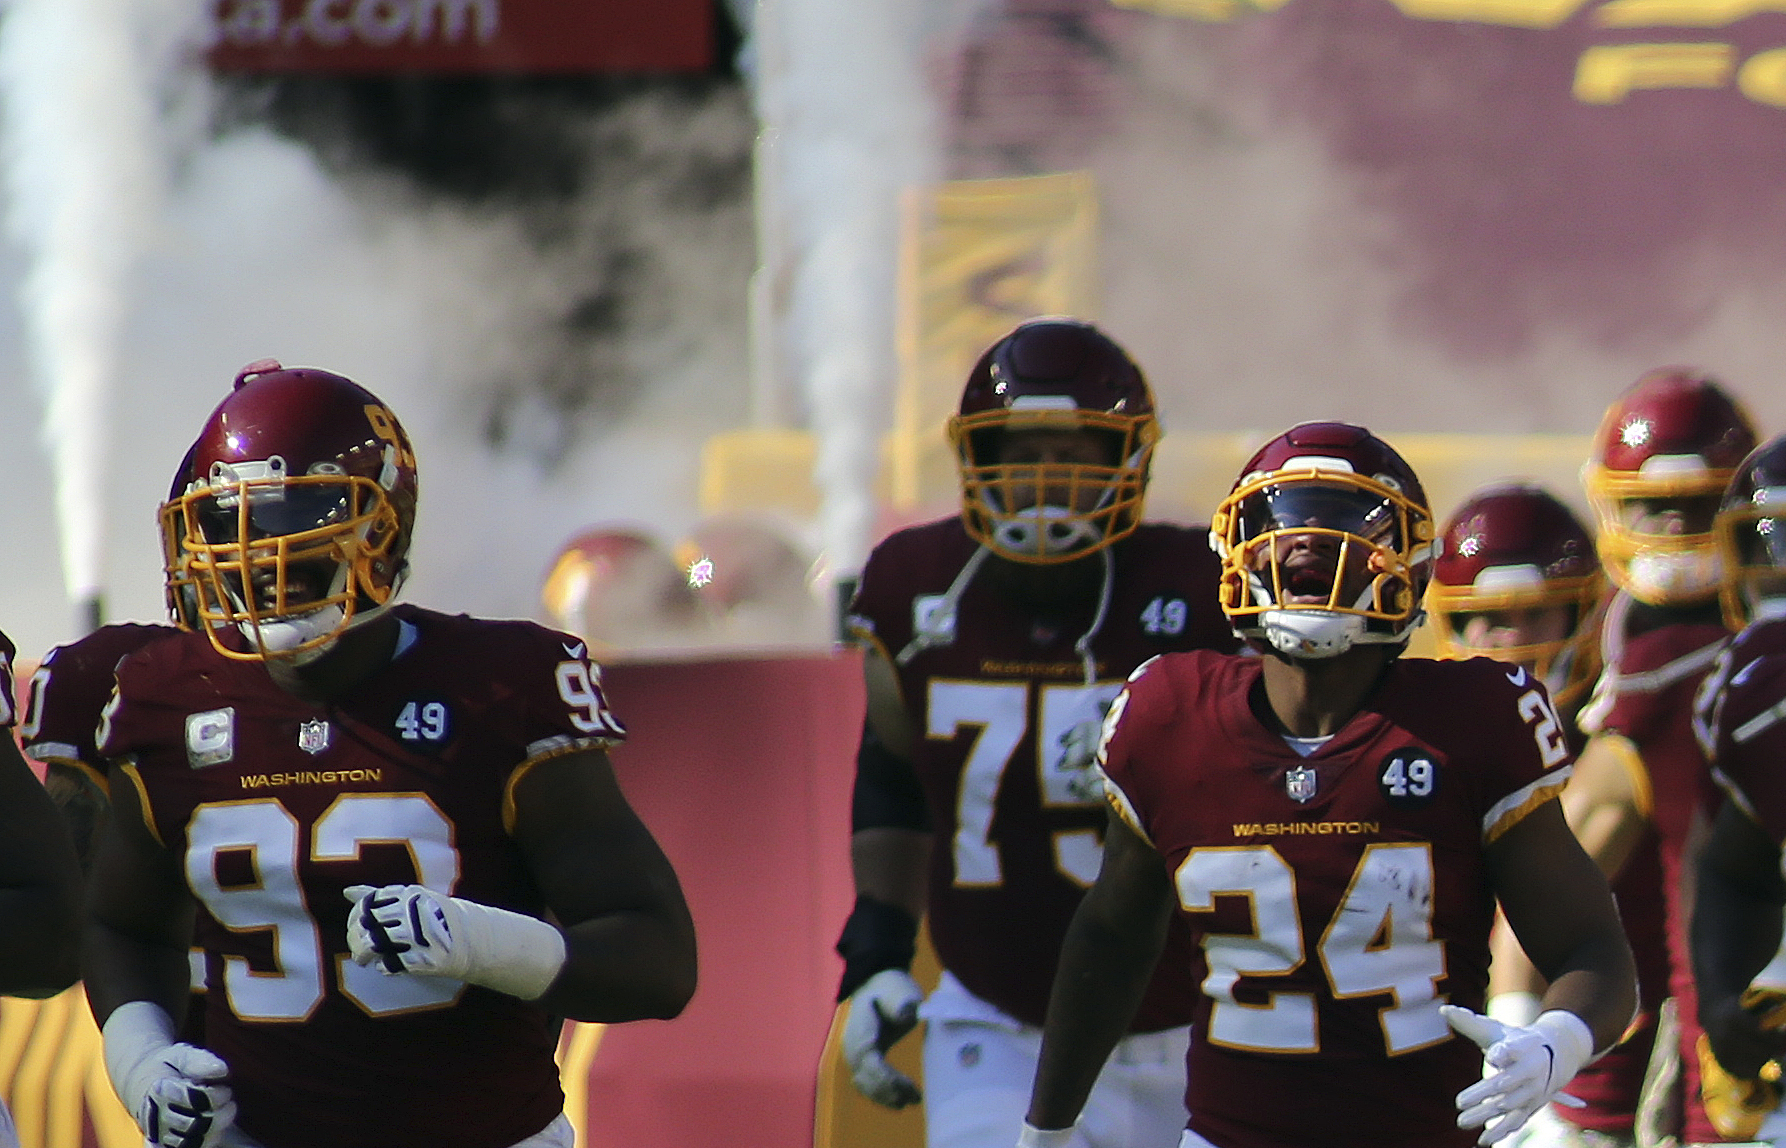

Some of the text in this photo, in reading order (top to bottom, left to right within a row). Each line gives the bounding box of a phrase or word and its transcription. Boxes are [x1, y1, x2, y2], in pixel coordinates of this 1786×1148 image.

[1140, 597, 1187, 635] 49
[188, 711, 229, 753] C
[395, 702, 446, 739] 49
[239, 768, 382, 789] WASHINGTON
[1381, 758, 1434, 797] 49
[1232, 821, 1380, 837] WASHINGTON
[185, 792, 461, 1023] 93
[1174, 842, 1457, 1057] 24
